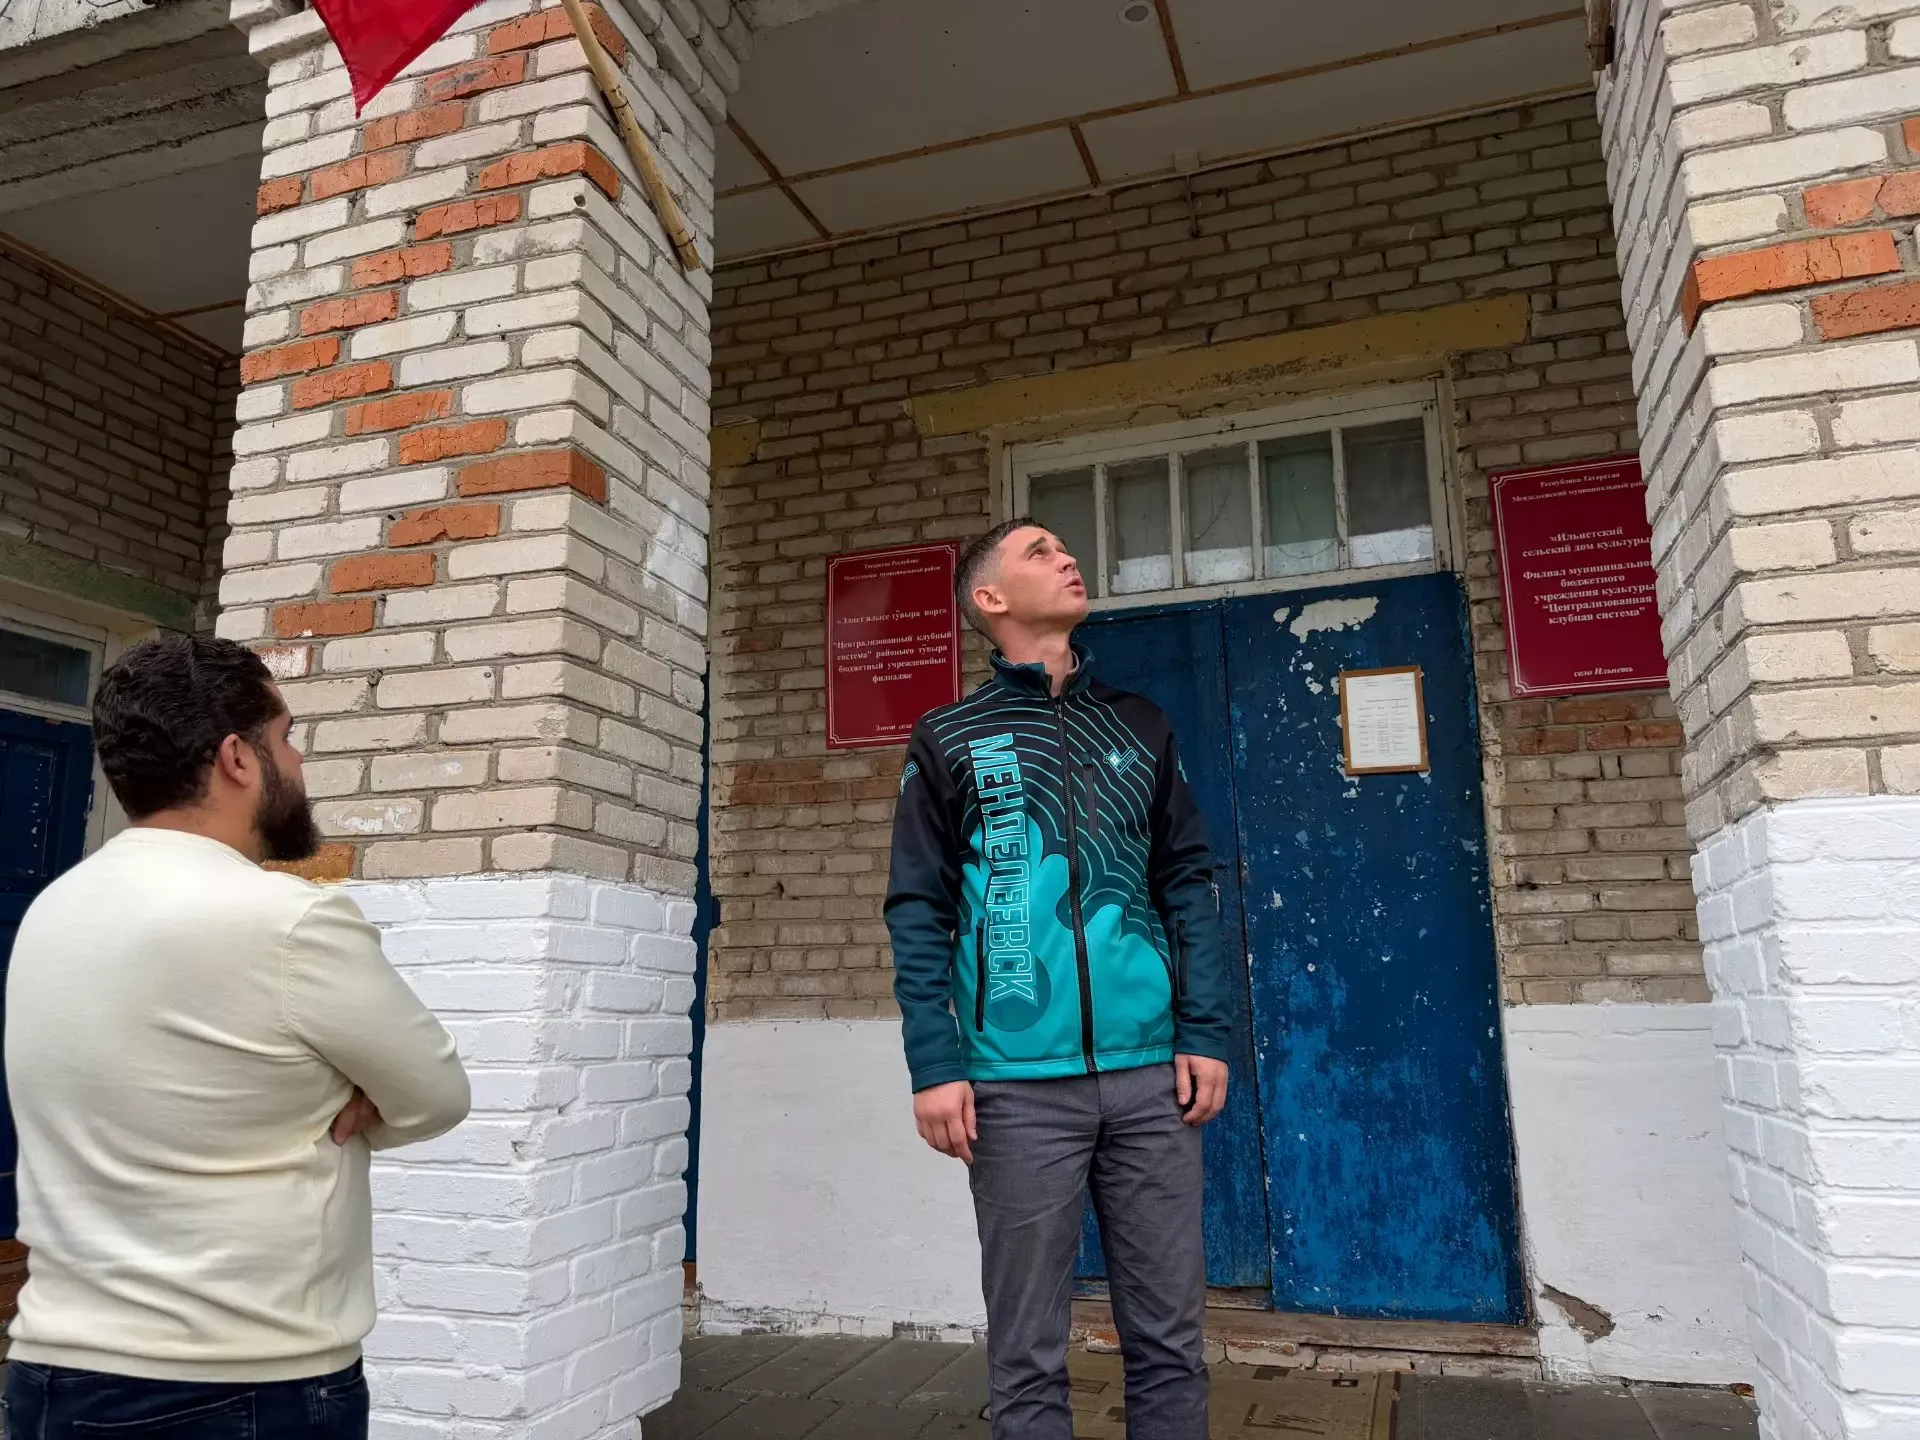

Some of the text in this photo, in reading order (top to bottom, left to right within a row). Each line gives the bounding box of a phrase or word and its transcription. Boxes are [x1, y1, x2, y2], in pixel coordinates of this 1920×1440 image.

[1522, 545, 1571, 558] сельский
[1574, 543, 1594, 552] дом
[1523, 560, 1652, 580] Филиал муниципально
[1601, 584, 1655, 598] культуры
[1549, 612, 1594, 626] клубная
[916, 631, 952, 643] клубный
